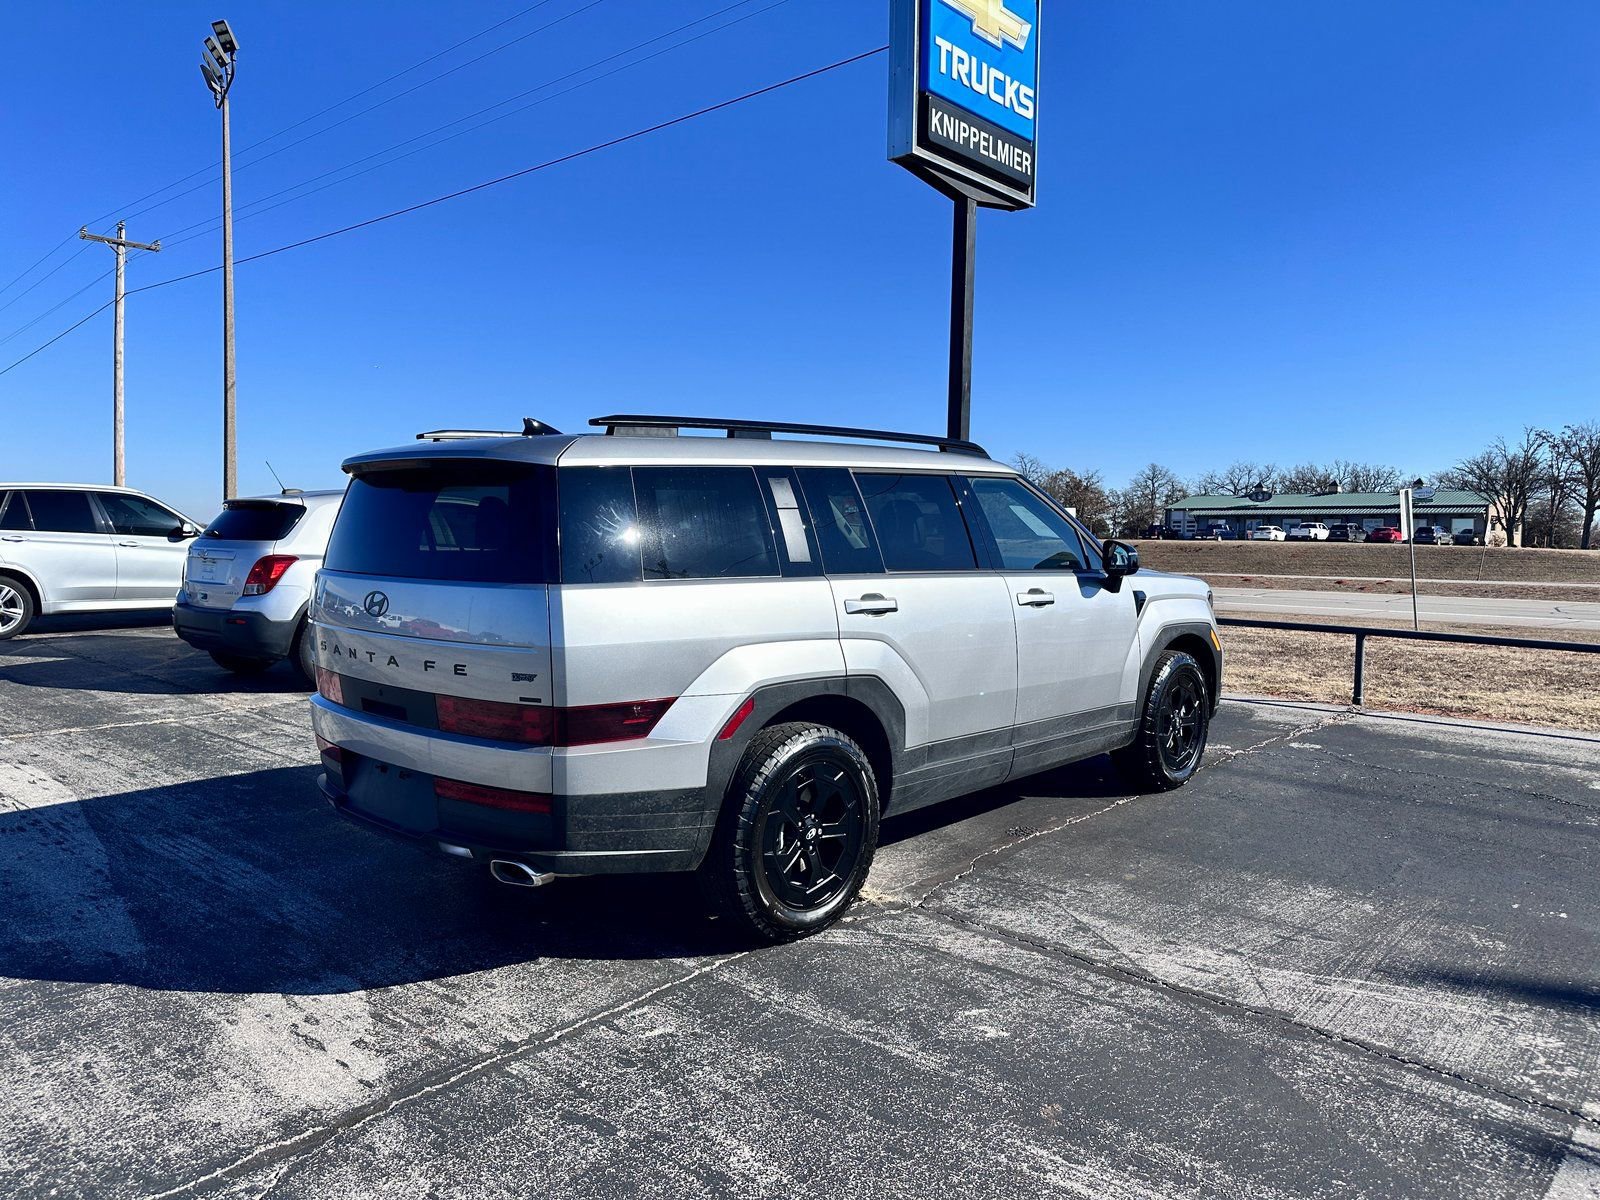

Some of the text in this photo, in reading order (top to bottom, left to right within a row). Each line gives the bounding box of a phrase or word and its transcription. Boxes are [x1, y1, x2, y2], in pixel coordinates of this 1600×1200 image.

[935, 35, 1034, 120] TRUCKS
[931, 108, 1031, 175] KNIPPELMIER
[320, 641, 467, 676] SANTA FE
